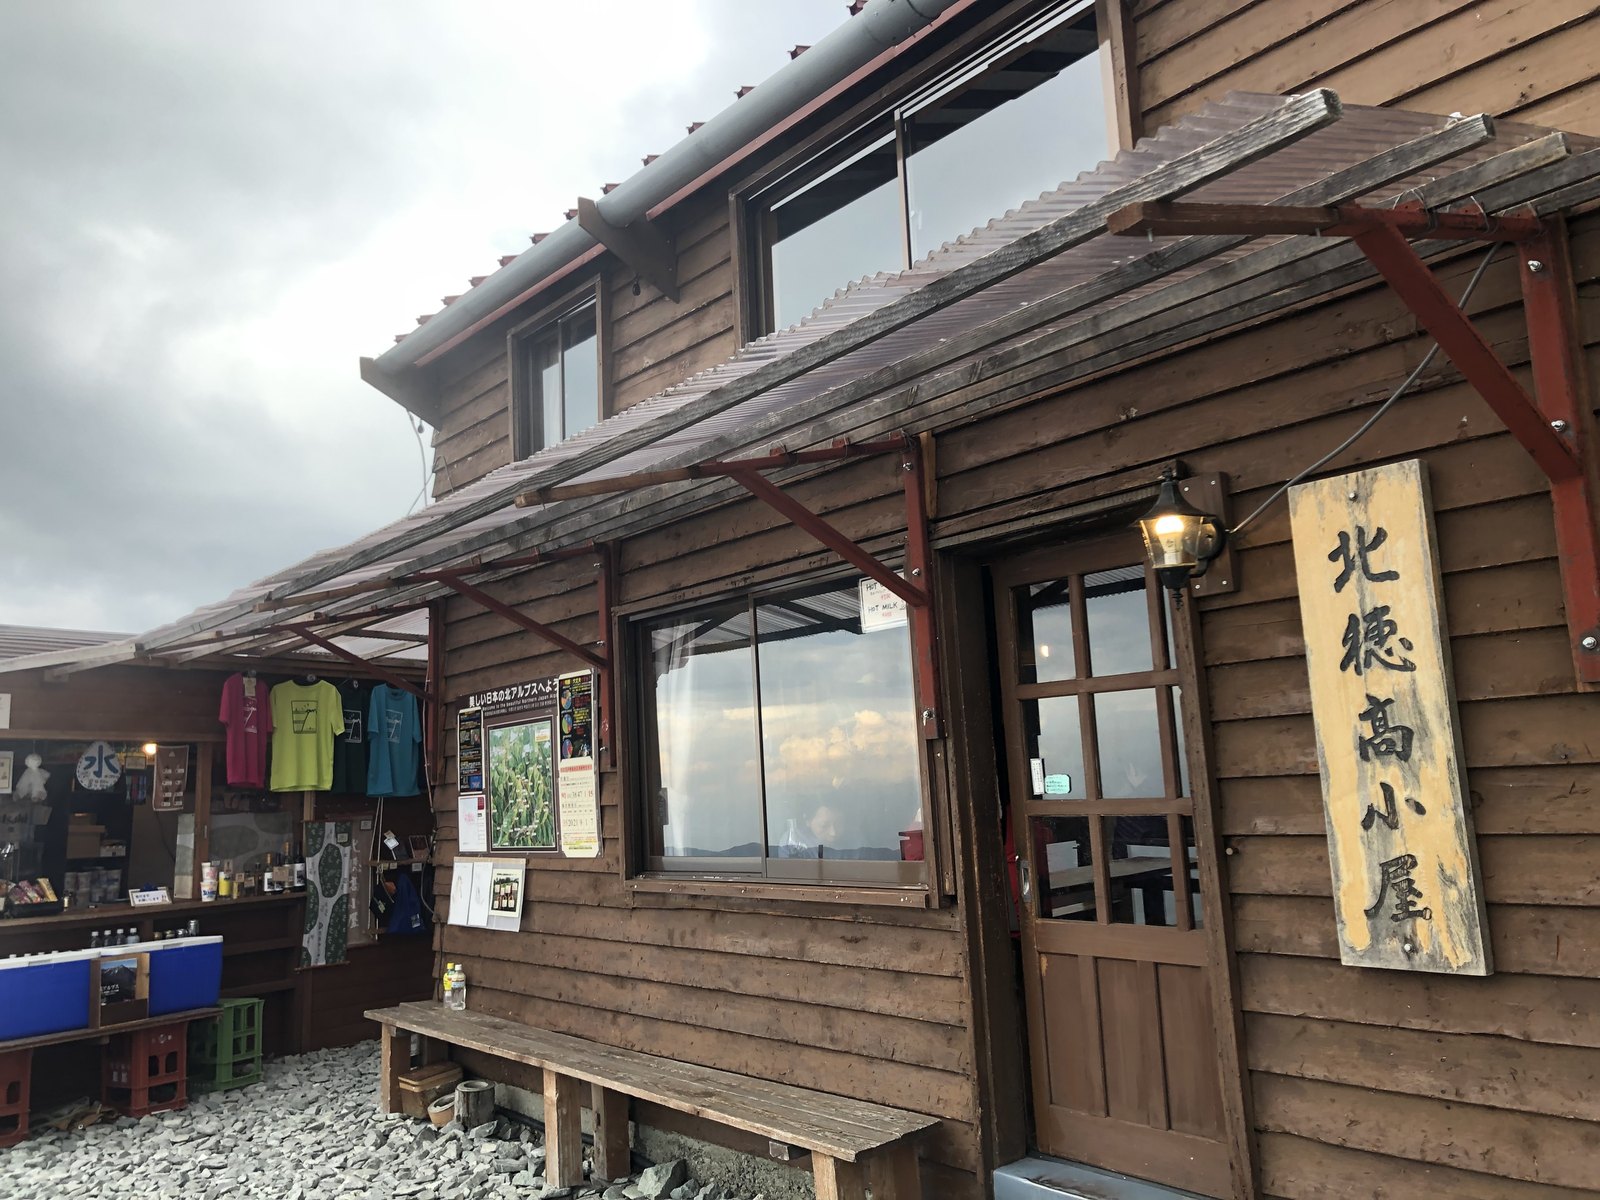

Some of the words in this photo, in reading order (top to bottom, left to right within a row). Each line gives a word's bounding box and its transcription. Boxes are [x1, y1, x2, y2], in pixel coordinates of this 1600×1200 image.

[866, 582, 878, 591] HOT
[868, 604, 879, 613] HOT
[882, 602, 898, 610] MILK
[83, 744, 119, 778] 水
